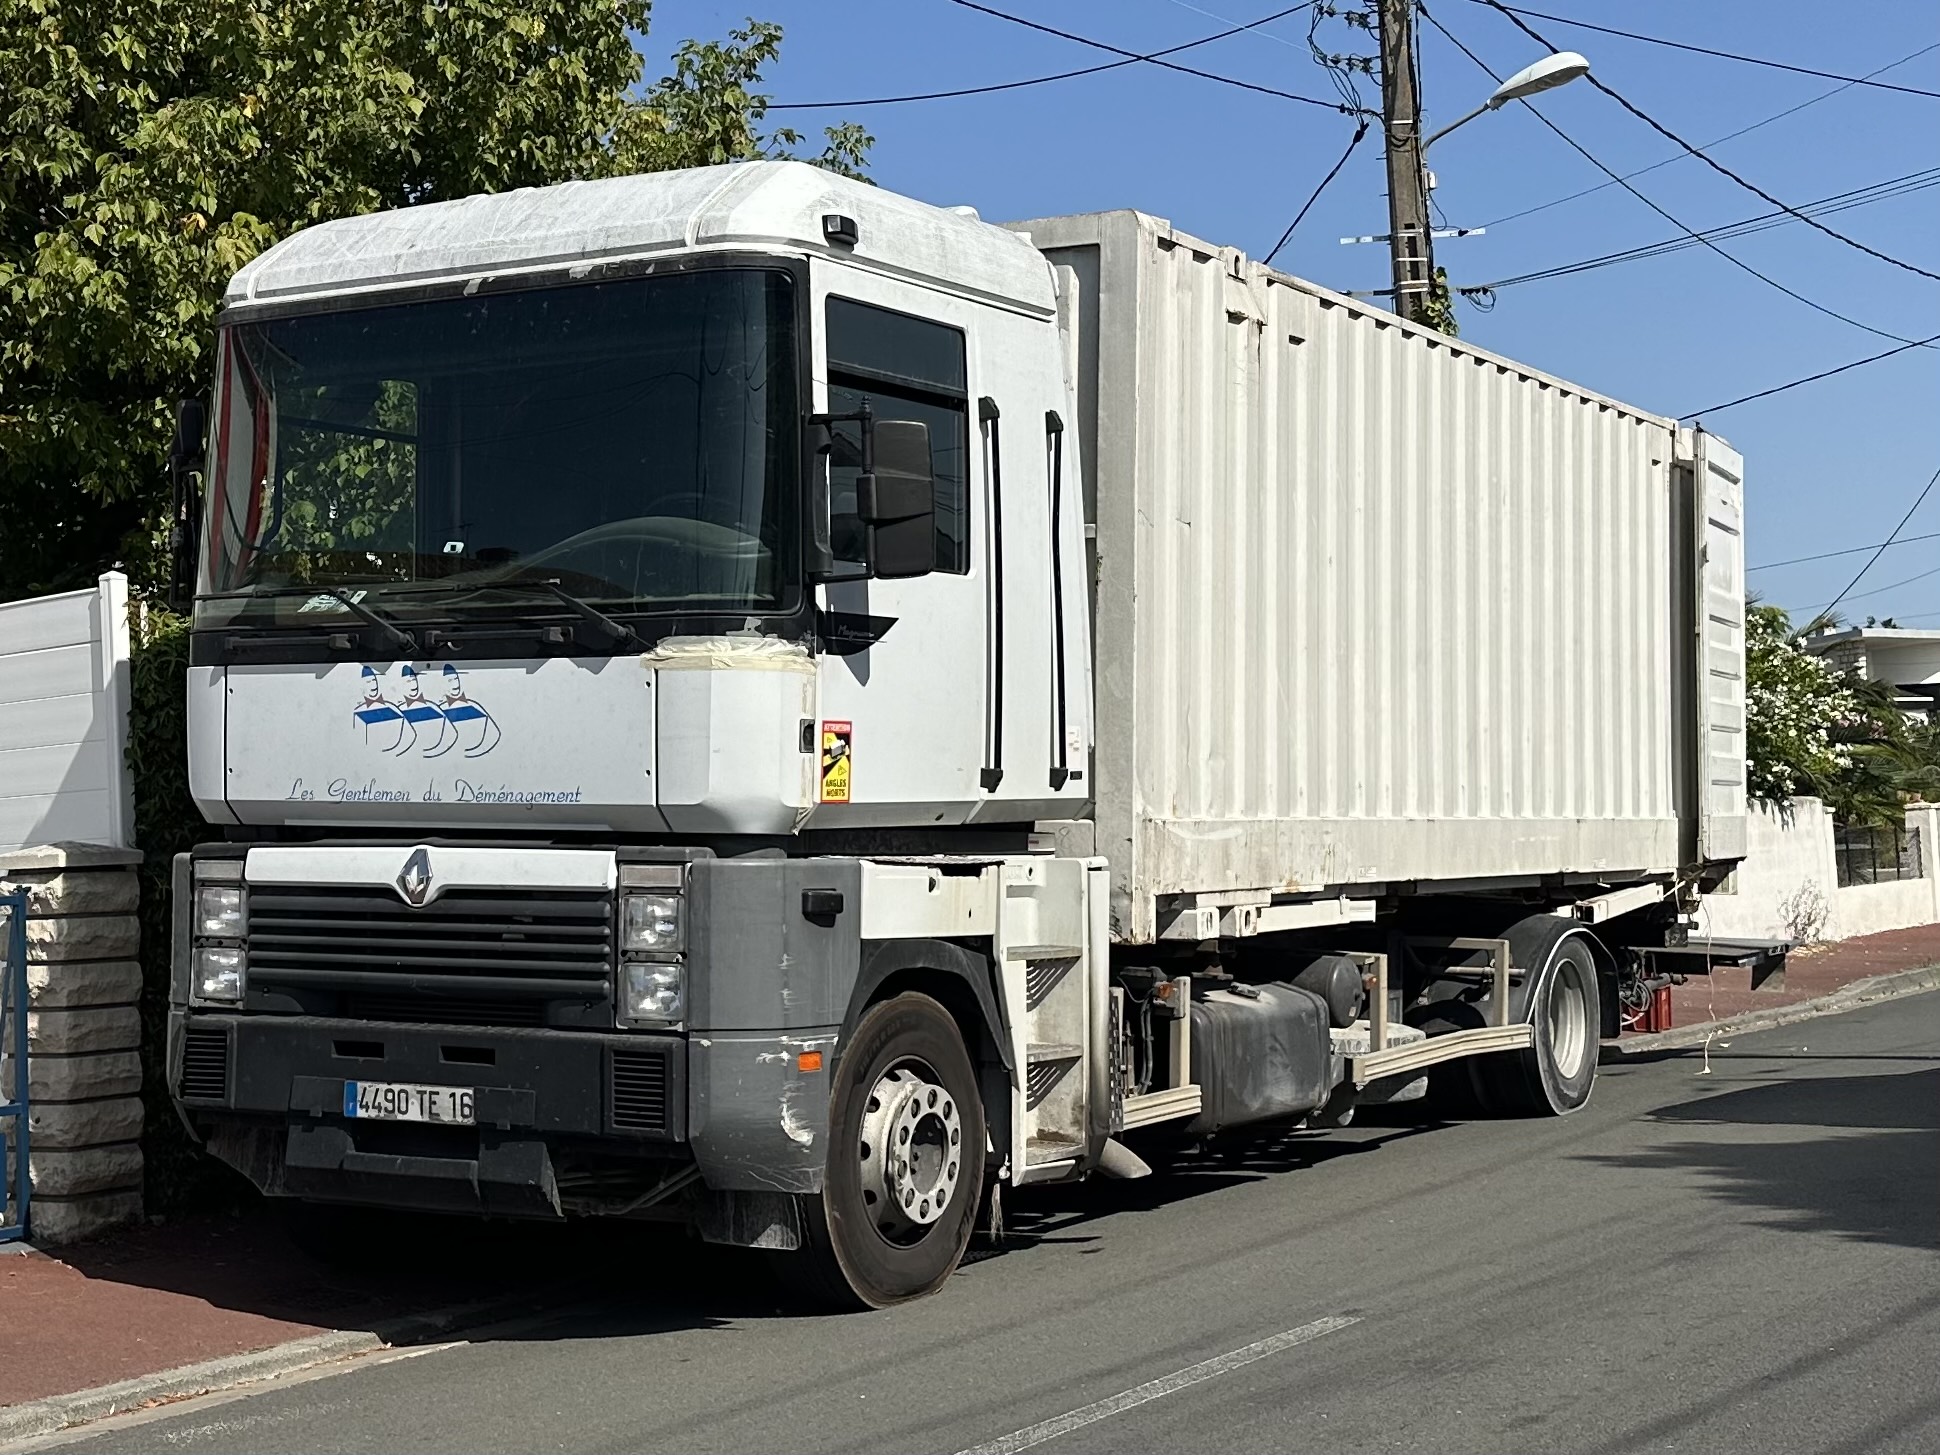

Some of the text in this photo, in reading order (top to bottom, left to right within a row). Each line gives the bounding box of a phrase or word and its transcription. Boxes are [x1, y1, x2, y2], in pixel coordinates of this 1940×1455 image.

[285, 777, 582, 811] Les Gentlemen du Déménagement
[825, 779, 847, 788] ANGLES
[826, 788, 846, 797] MORTS
[359, 1086, 474, 1119] 4490 TE 16
